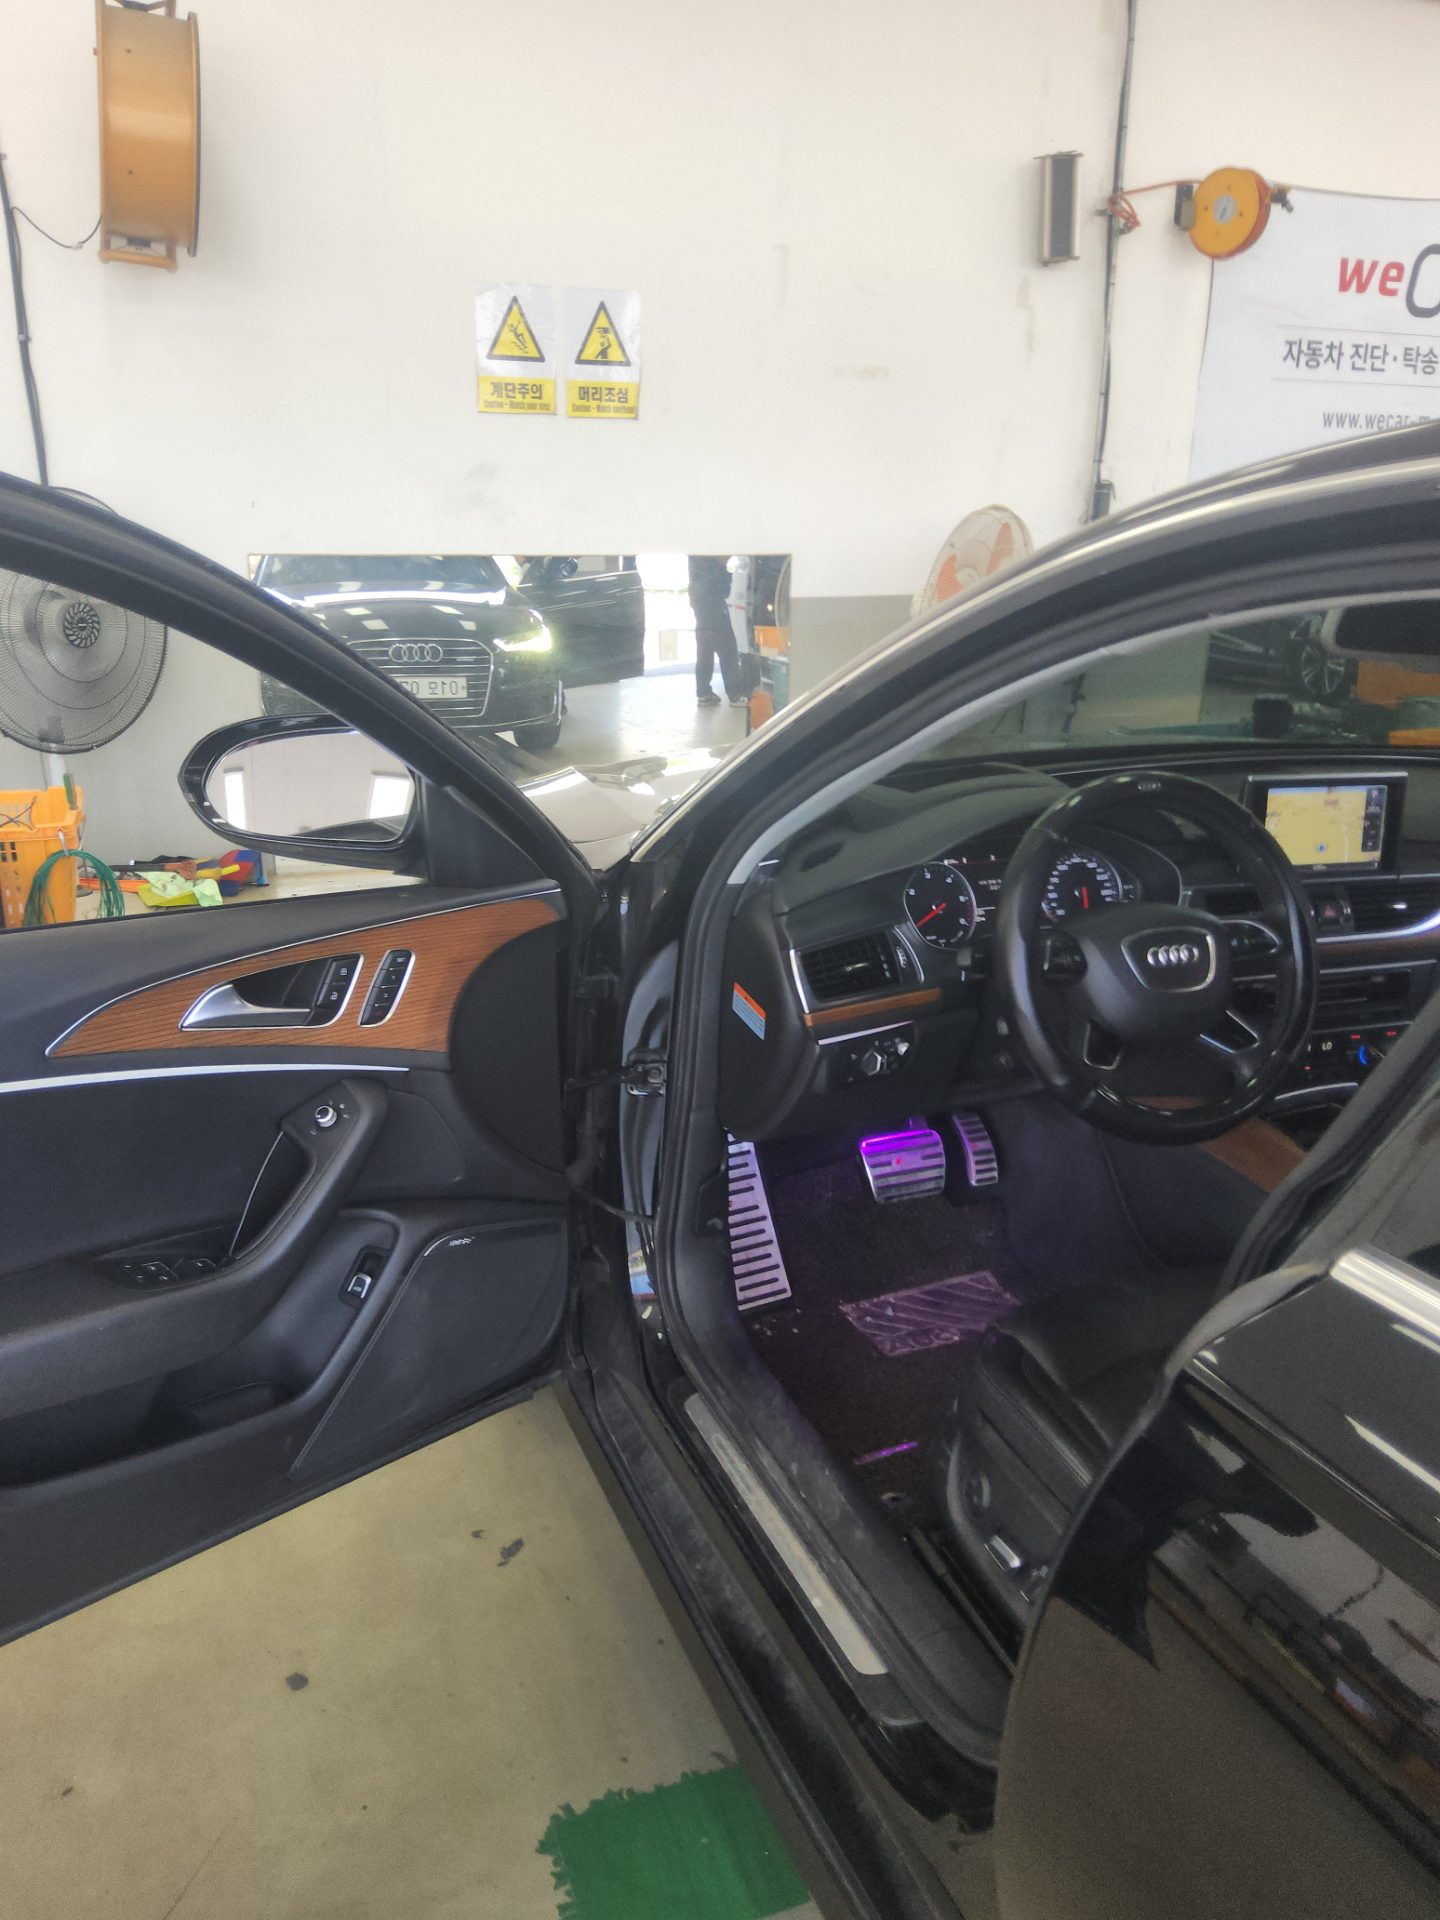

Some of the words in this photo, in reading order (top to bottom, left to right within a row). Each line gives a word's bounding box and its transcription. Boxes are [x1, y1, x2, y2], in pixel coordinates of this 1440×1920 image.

[1283, 338, 1344, 370] 자동차
[490, 382, 543, 400] 계단주의
[578, 386, 629, 404] 머리조심
